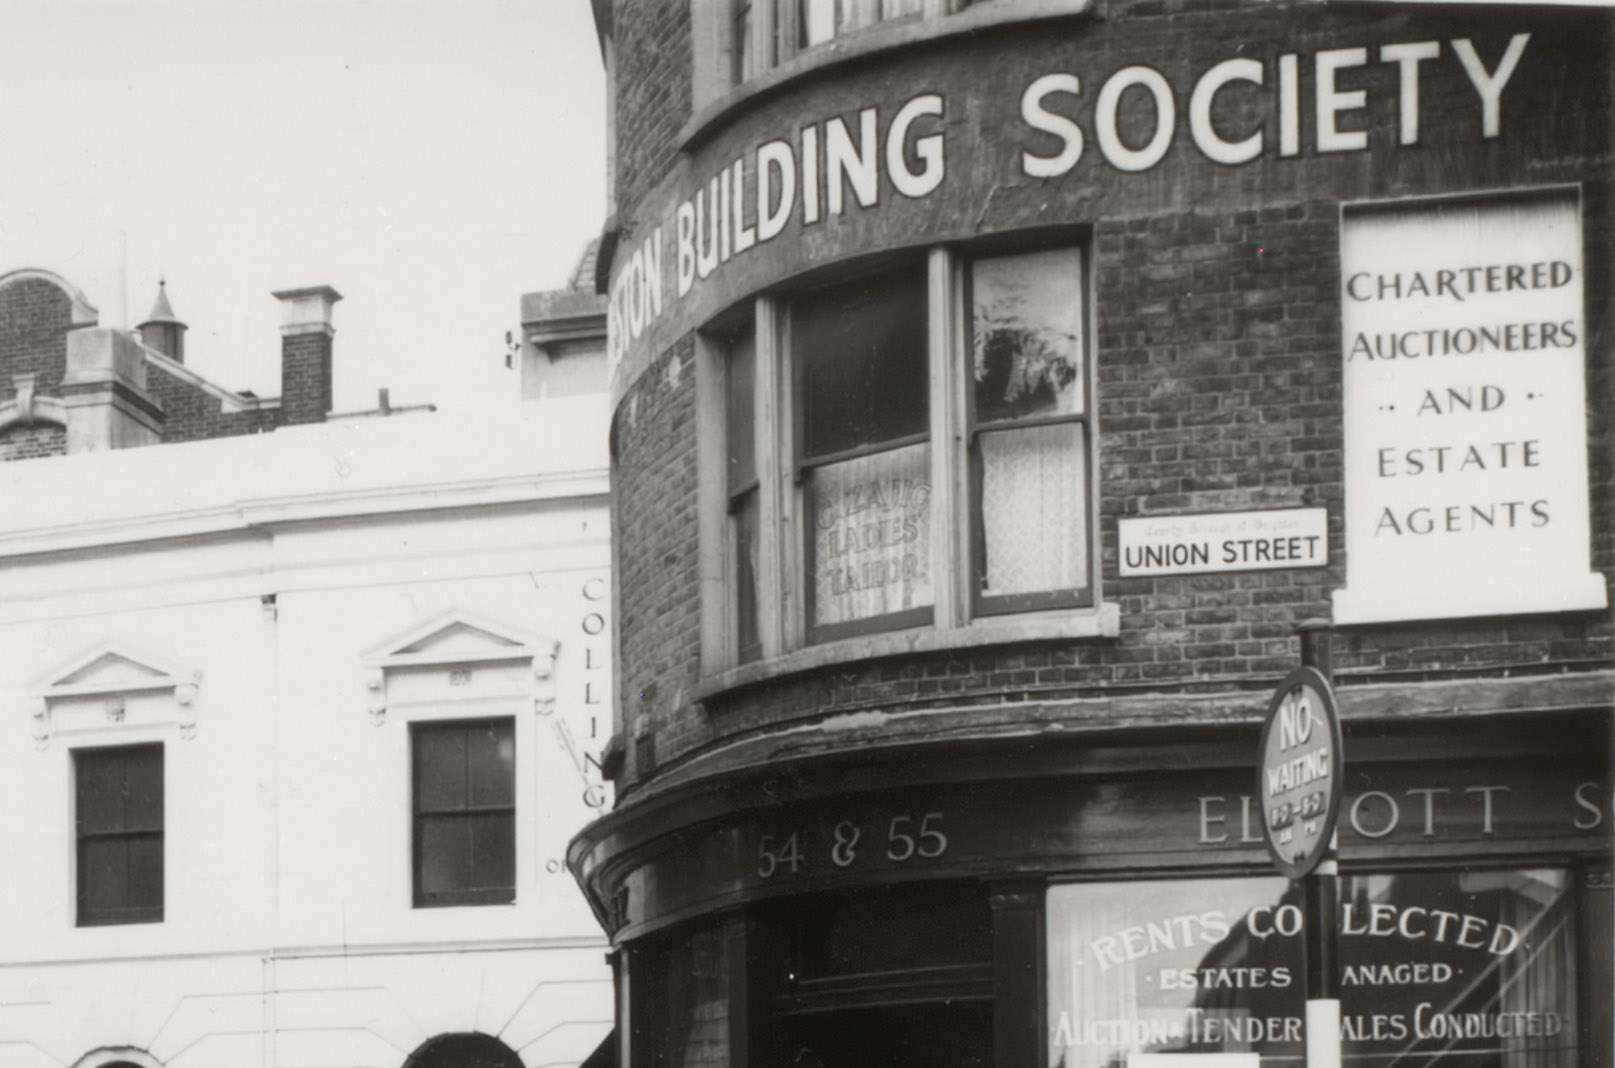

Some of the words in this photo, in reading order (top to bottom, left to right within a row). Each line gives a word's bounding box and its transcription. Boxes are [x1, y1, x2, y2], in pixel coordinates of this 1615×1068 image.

[678, 95, 945, 298] BUILDING
[1020, 33, 1531, 178] SOCIETY
[1346, 260, 1573, 302] CHARTERED
[1347, 319, 1577, 362] AUCTIONEERS
[1417, 385, 1505, 416] AND
[1377, 440, 1541, 478] ESTATE
[1374, 500, 1550, 537] AGENTS
[1125, 543, 1209, 568] UNION
[1222, 536, 1320, 563] STREET
[1279, 697, 1312, 752] NO
[1267, 747, 1329, 798] WAITING
[1198, 785, 1511, 843] ELOTT
[1573, 782, 1603, 830] S
[757, 832, 805, 878] 54
[832, 820, 860, 867] &
[886, 812, 948, 861] 55
[1089, 909, 1232, 972] RENTS
[1246, 903, 1520, 956] COLECTED
[1159, 966, 1292, 990] ESTATES
[1340, 963, 1453, 986] ANAGED
[1053, 1010, 1168, 1047] AUCTION
[1185, 1007, 1303, 1043] TENDER
[1340, 1014, 1407, 1041] ALES
[1414, 1002, 1563, 1040] CONDUCTED
